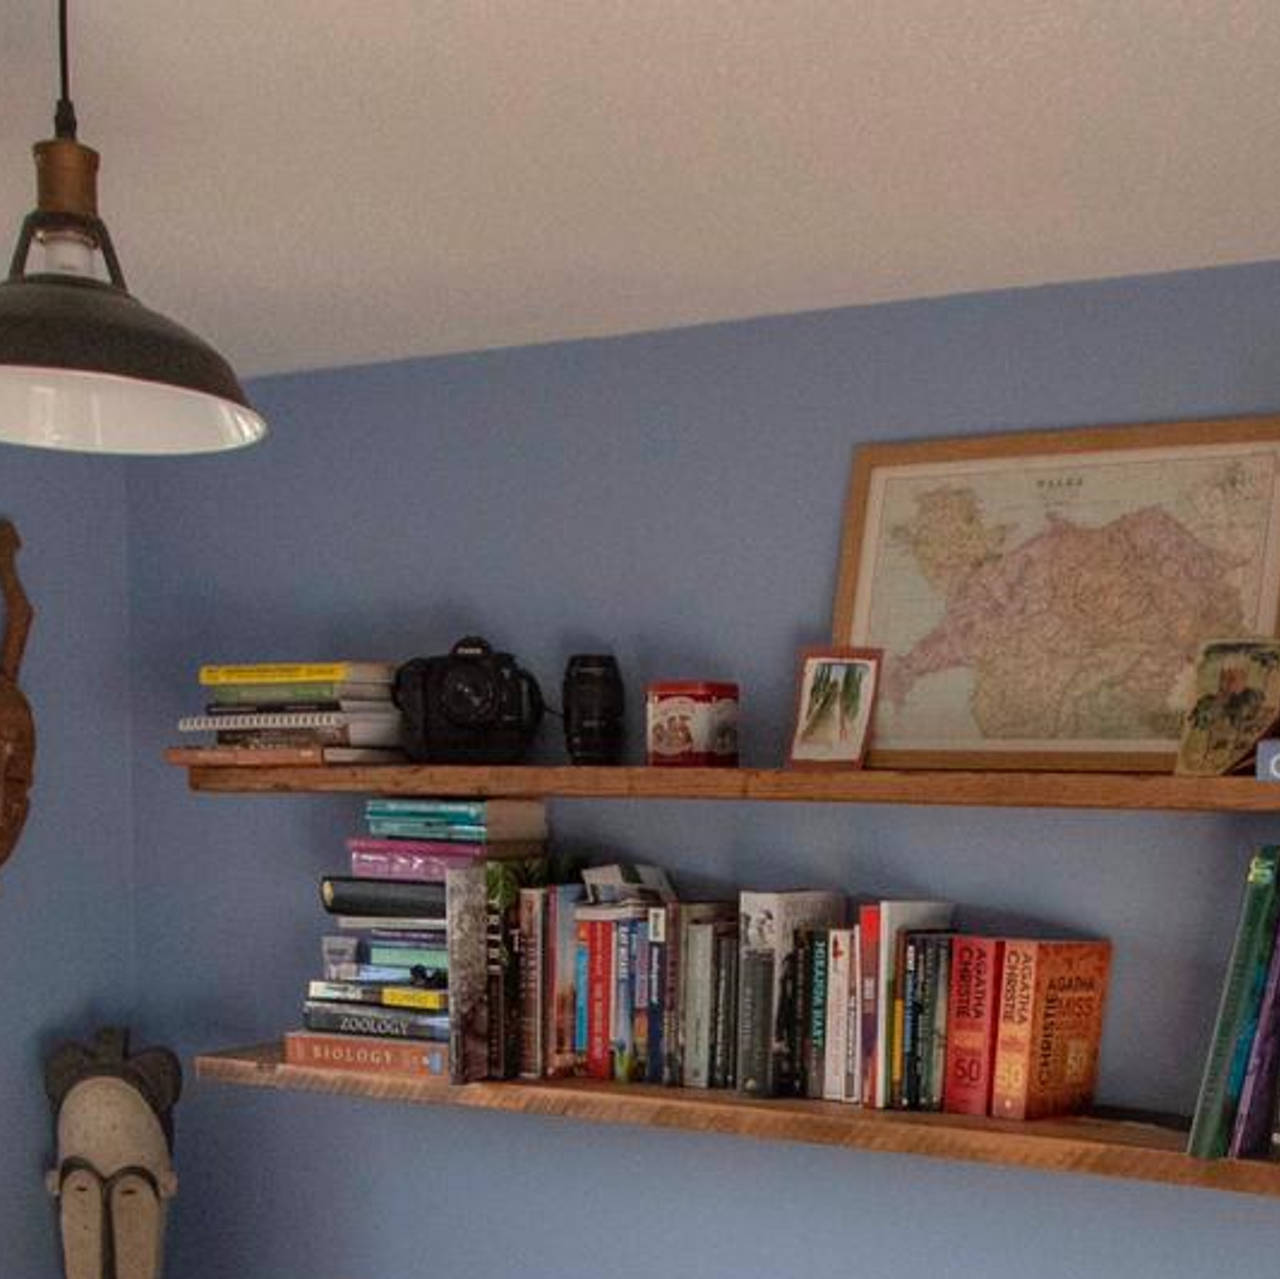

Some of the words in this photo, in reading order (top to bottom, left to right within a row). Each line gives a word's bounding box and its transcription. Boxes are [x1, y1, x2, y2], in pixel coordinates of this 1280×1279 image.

[956, 947, 974, 1018] CHRISTIE
[973, 948, 987, 1019] AGATHA
[1002, 950, 1020, 1024] CHRISTIE
[1018, 952, 1032, 1025] AGATHA
[313, 1045, 393, 1065] BIOLOGY
[339, 1016, 410, 1036] ZOOLOGY
